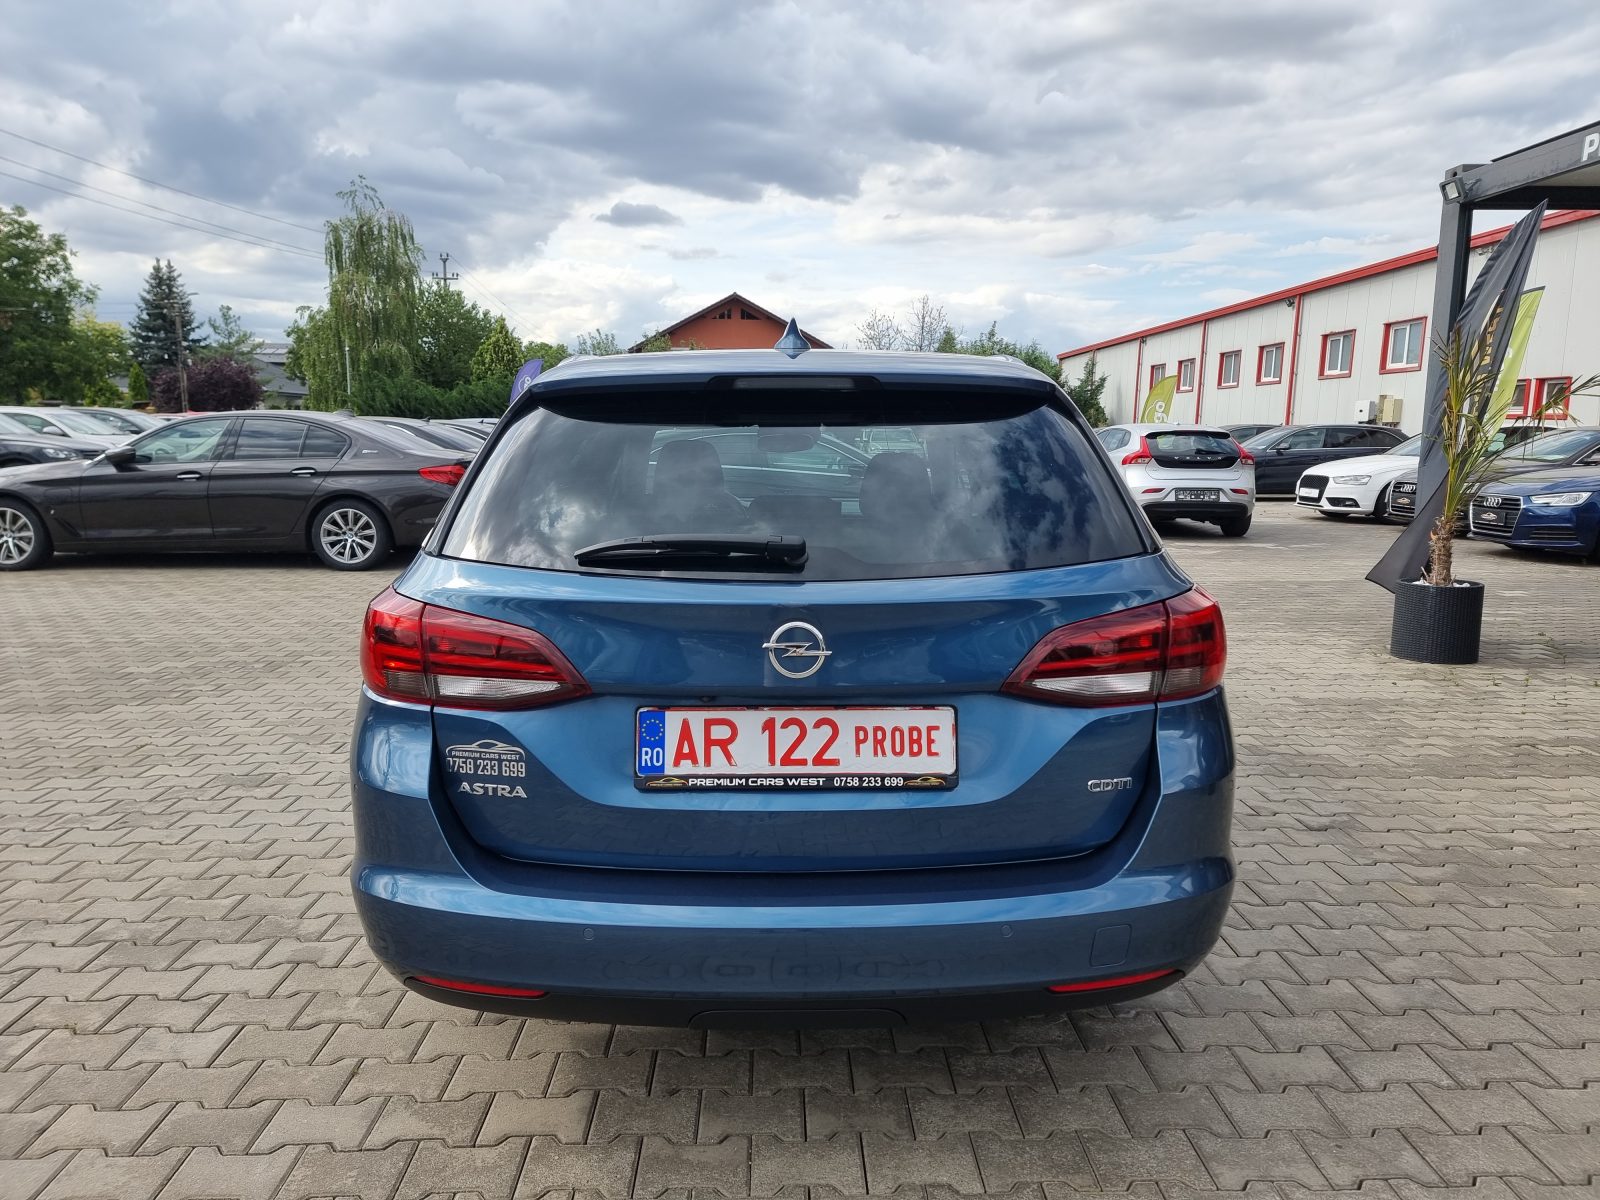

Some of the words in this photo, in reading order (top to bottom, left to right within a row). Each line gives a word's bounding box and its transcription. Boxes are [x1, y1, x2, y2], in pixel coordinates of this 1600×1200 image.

[1582, 132, 1600, 161] P
[672, 718, 738, 767] AR
[761, 717, 840, 767] 122
[855, 725, 940, 757] PROBE
[641, 747, 663, 767] RO
[477, 760, 498, 775] 233
[502, 762, 526, 777] 699
[458, 782, 527, 798] ASTRA
[688, 778, 746, 787] PREMIUM
[748, 777, 784, 786] CARS
[786, 777, 826, 786] WEST
[833, 776, 859, 787] 0758
[862, 776, 882, 787] 233
[884, 776, 904, 787] 699
[1088, 777, 1132, 792] CDTI
